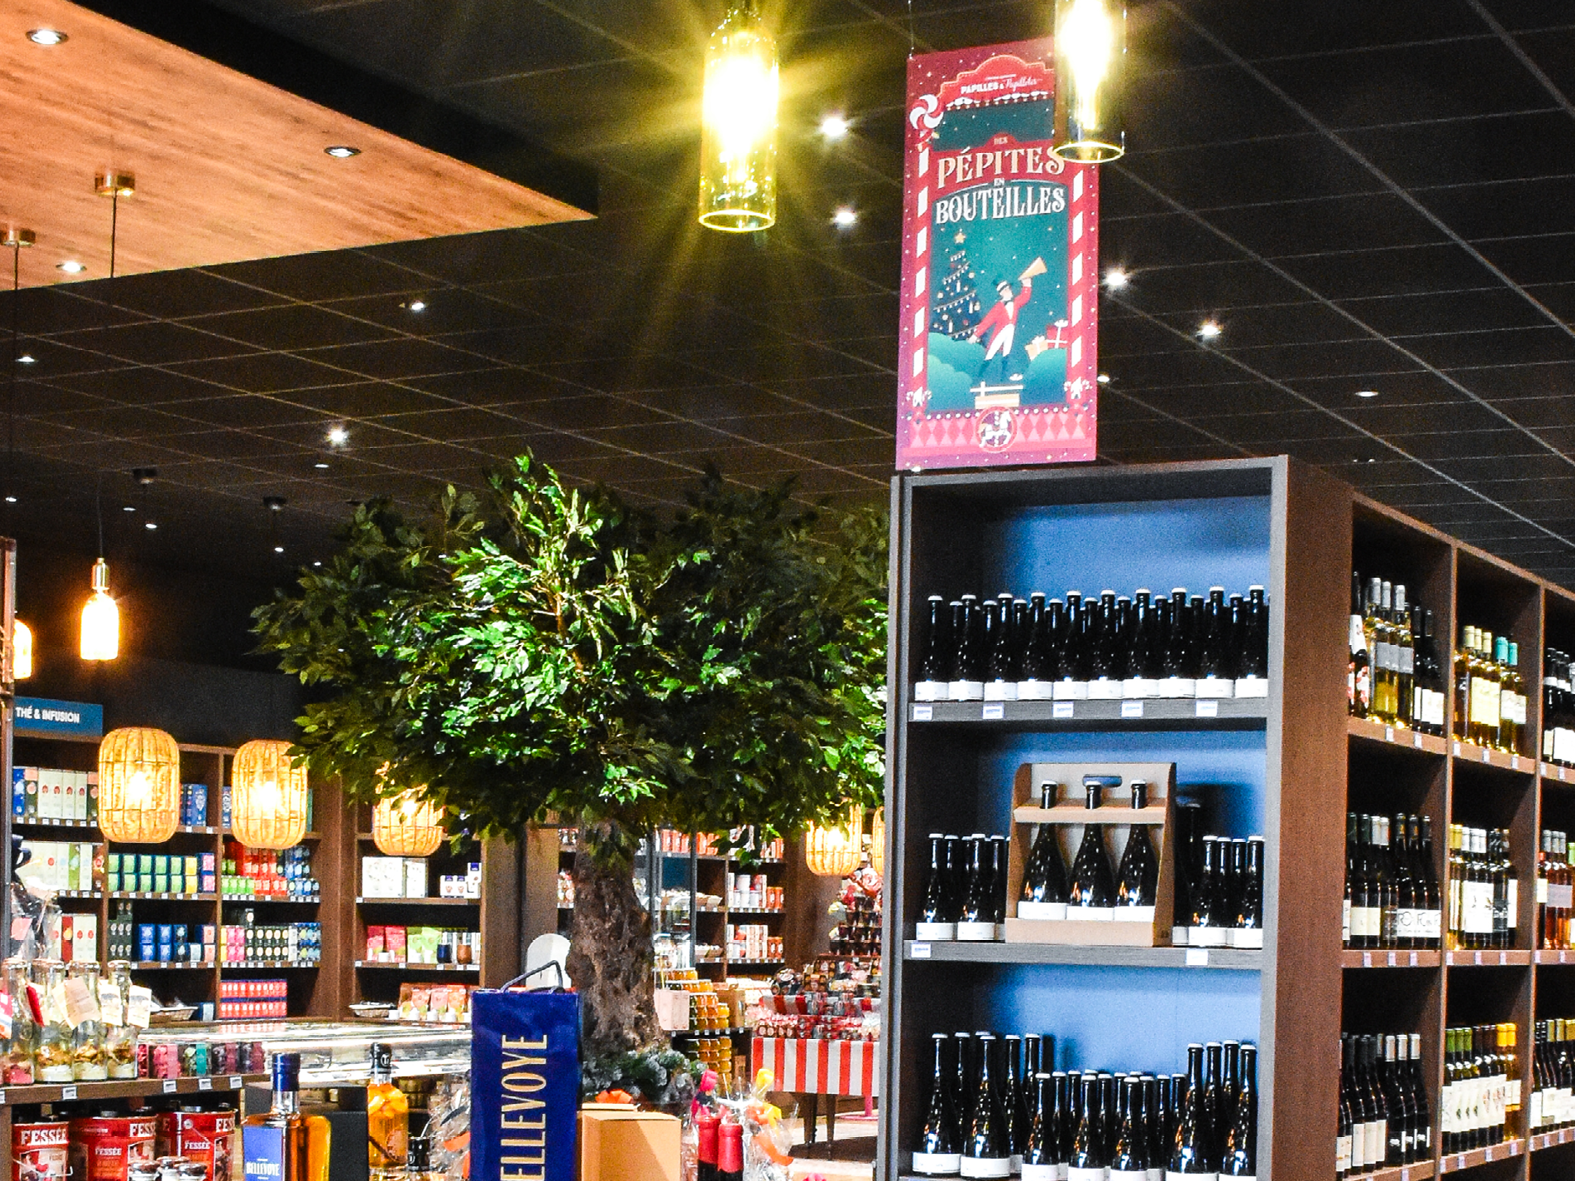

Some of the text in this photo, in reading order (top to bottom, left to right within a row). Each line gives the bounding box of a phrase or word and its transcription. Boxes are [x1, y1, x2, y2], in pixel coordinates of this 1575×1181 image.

[960, 81, 998, 94] PAPILLES
[937, 146, 1065, 189] PÉPITES
[993, 177, 1005, 187] EN
[935, 186, 1066, 224] BOUTEILLES
[15, 705, 80, 724] THÉ & INFUSION
[246, 1161, 281, 1177] BELLEVOYE
